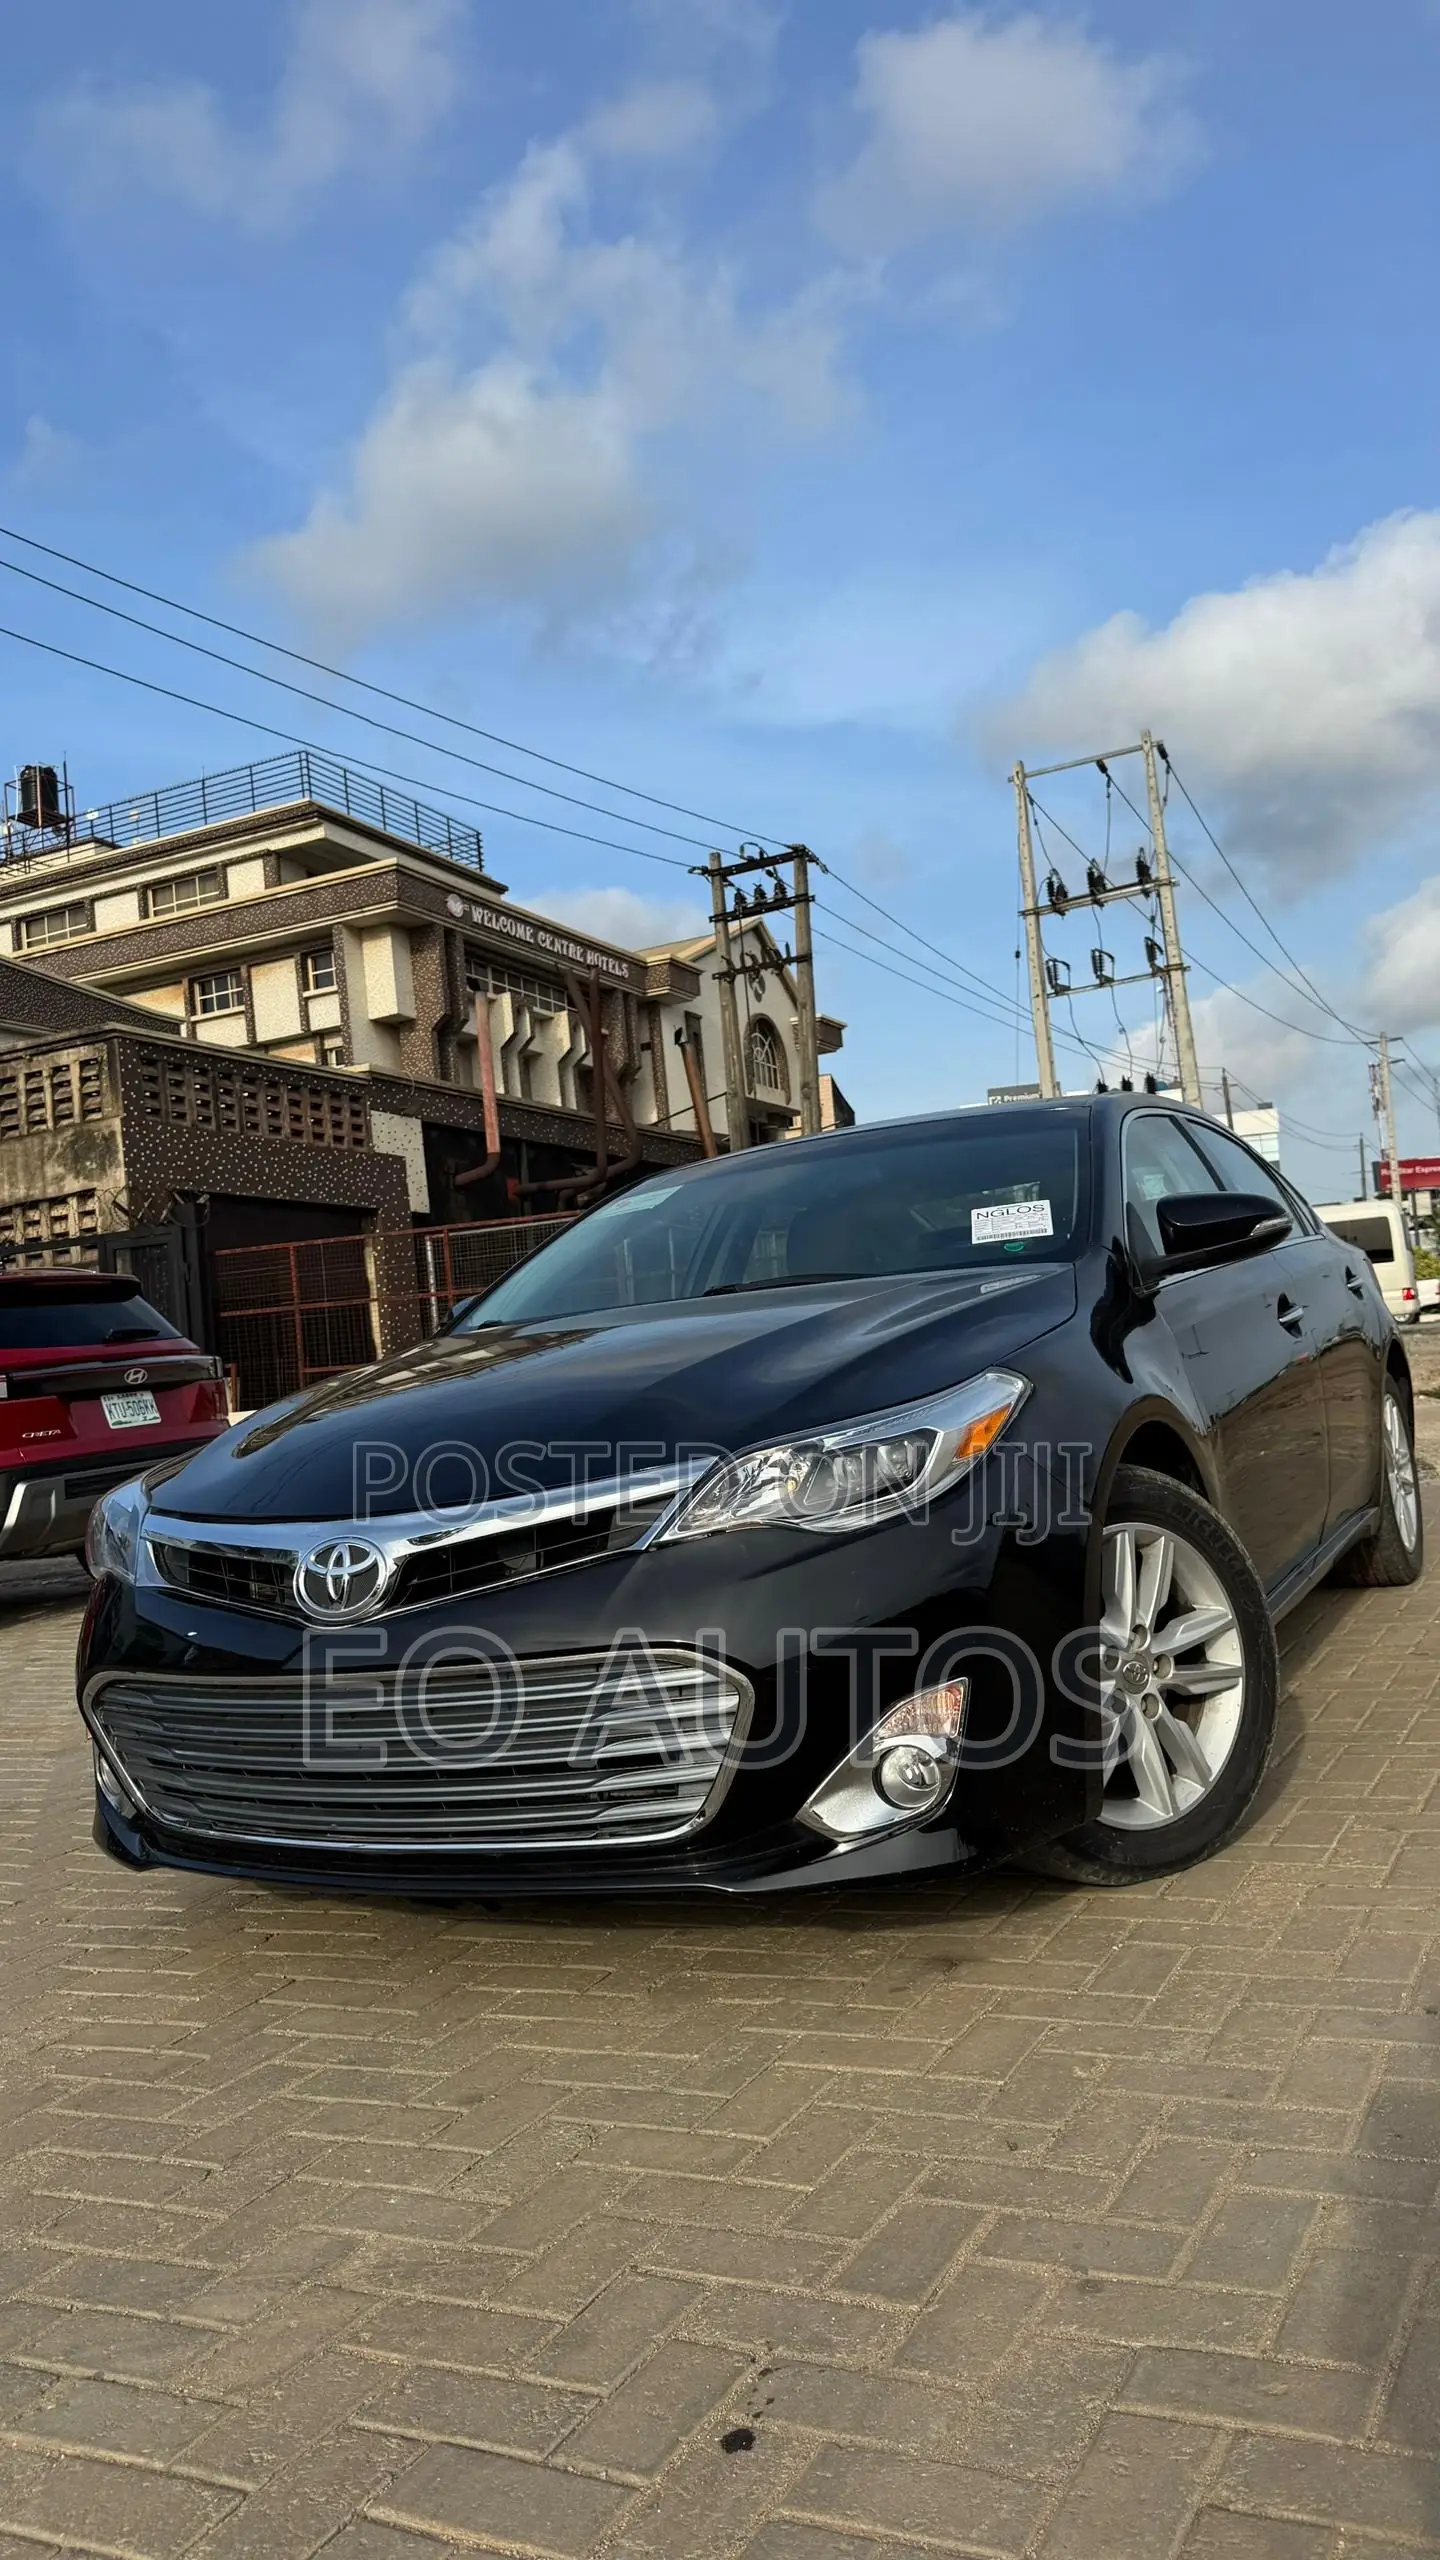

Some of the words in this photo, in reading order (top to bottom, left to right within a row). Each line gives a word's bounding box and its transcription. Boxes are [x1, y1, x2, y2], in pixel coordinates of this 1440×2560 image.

[470, 905, 535, 944] WELCOME
[537, 931, 585, 963] CENTRE
[586, 950, 630, 979] HOTELS
[976, 1204, 1045, 1219] NGLOS
[21, 1429, 62, 1438] CRETA
